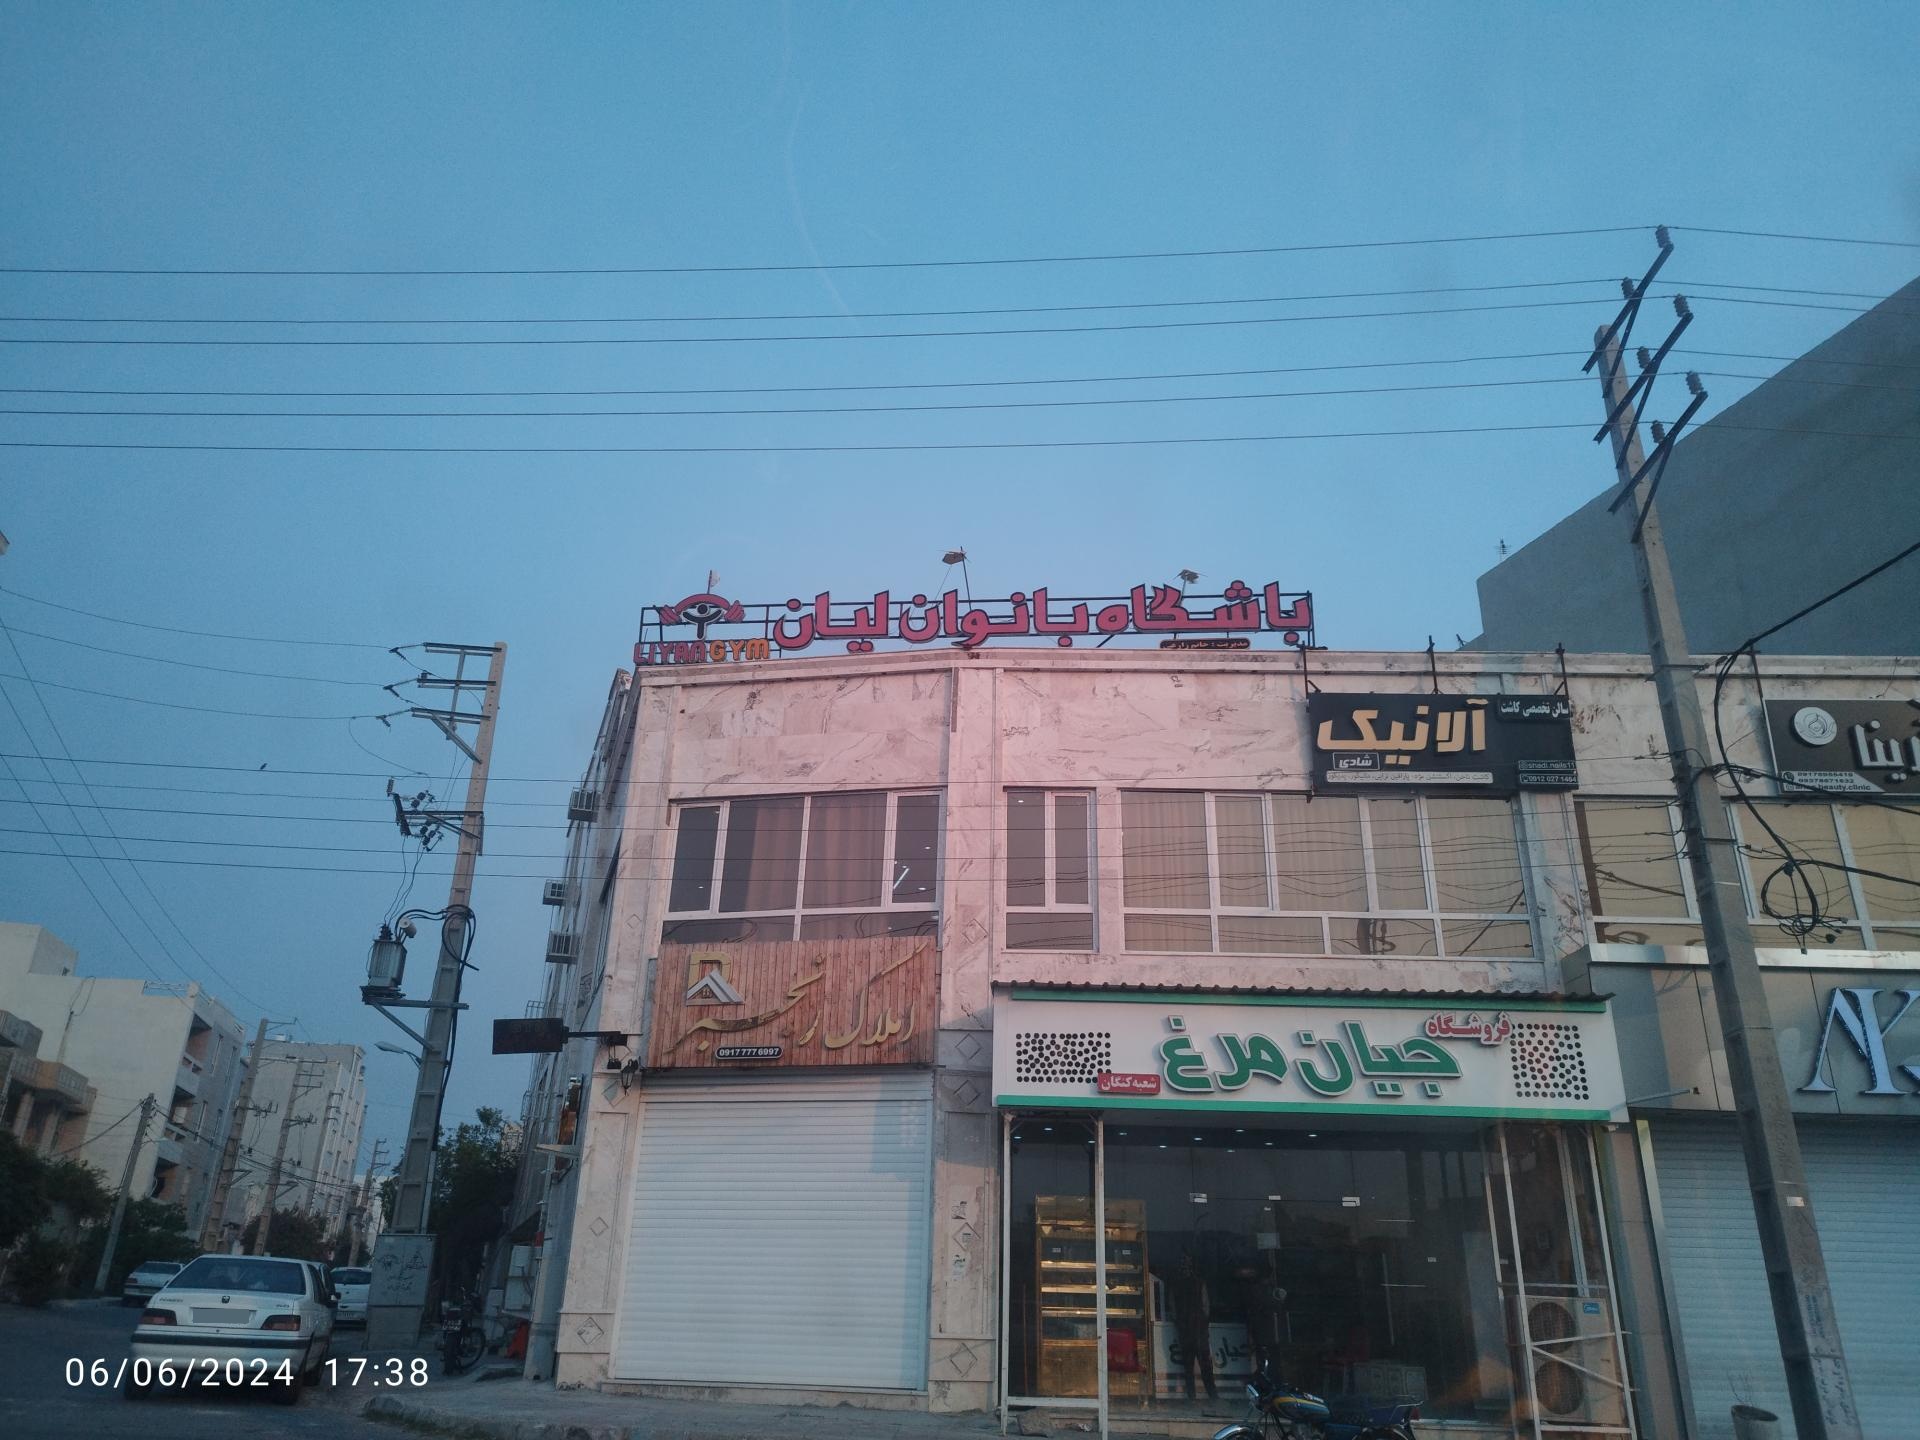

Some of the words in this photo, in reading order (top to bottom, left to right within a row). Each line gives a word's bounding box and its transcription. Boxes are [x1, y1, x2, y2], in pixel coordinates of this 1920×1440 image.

[772, 588, 891, 654] لیان
[898, 586, 1090, 650] بانوان
[1096, 579, 1313, 647] باشگاه
[709, 638, 771, 663] GYM
[1316, 698, 1489, 766] آلانیک
[1522, 702, 1551, 718] تخصصی
[1551, 702, 1569, 718] سالن
[1338, 755, 1373, 768] شادی
[663, 954, 828, 1055] رنجبر
[823, 941, 929, 1050] املاک
[1157, 1014, 1288, 1091] مرغ
[1295, 1019, 1463, 1097] جیان
[1423, 1010, 1512, 1047] فروشگاه
[1100, 1075, 1131, 1091] کنگان
[1131, 1076, 1159, 1092] شعبه
